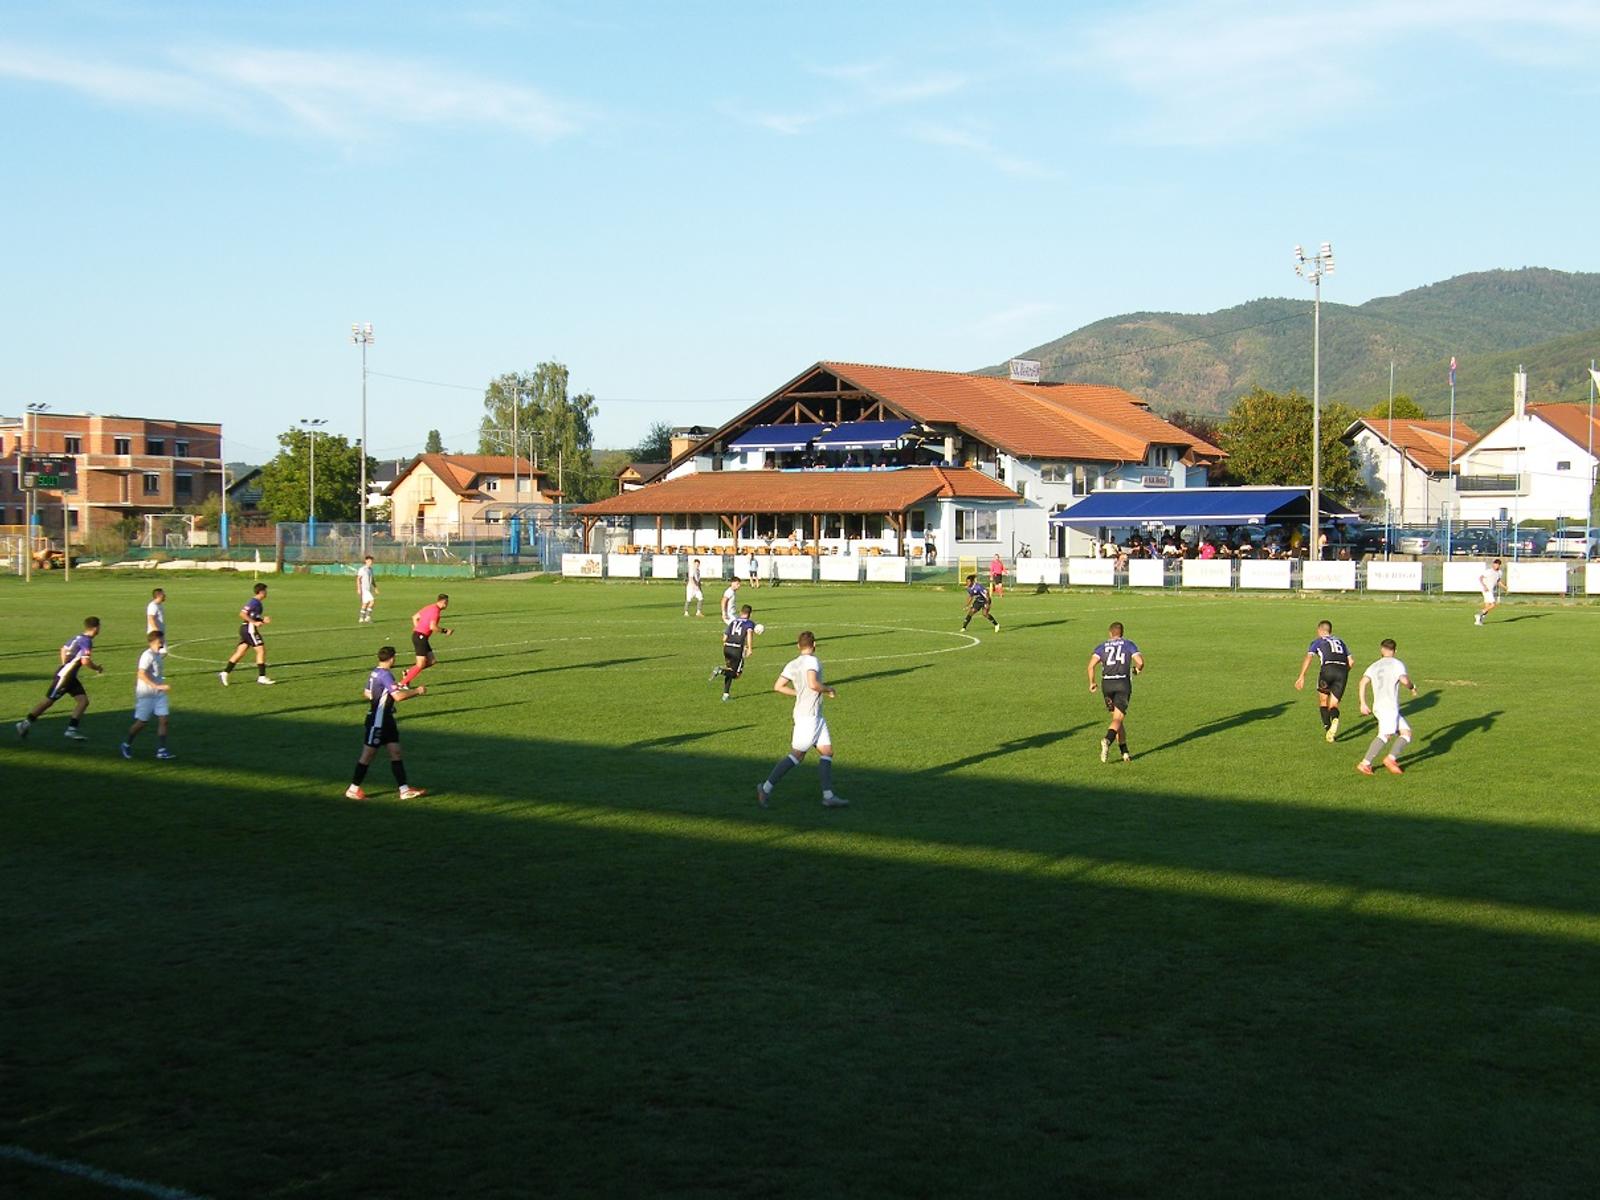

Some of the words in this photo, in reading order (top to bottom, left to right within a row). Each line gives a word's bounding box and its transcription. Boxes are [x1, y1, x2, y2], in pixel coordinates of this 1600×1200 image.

[731, 621, 742, 636] 14
[1327, 639, 1343, 654] 16
[1104, 645, 1126, 666] 24
